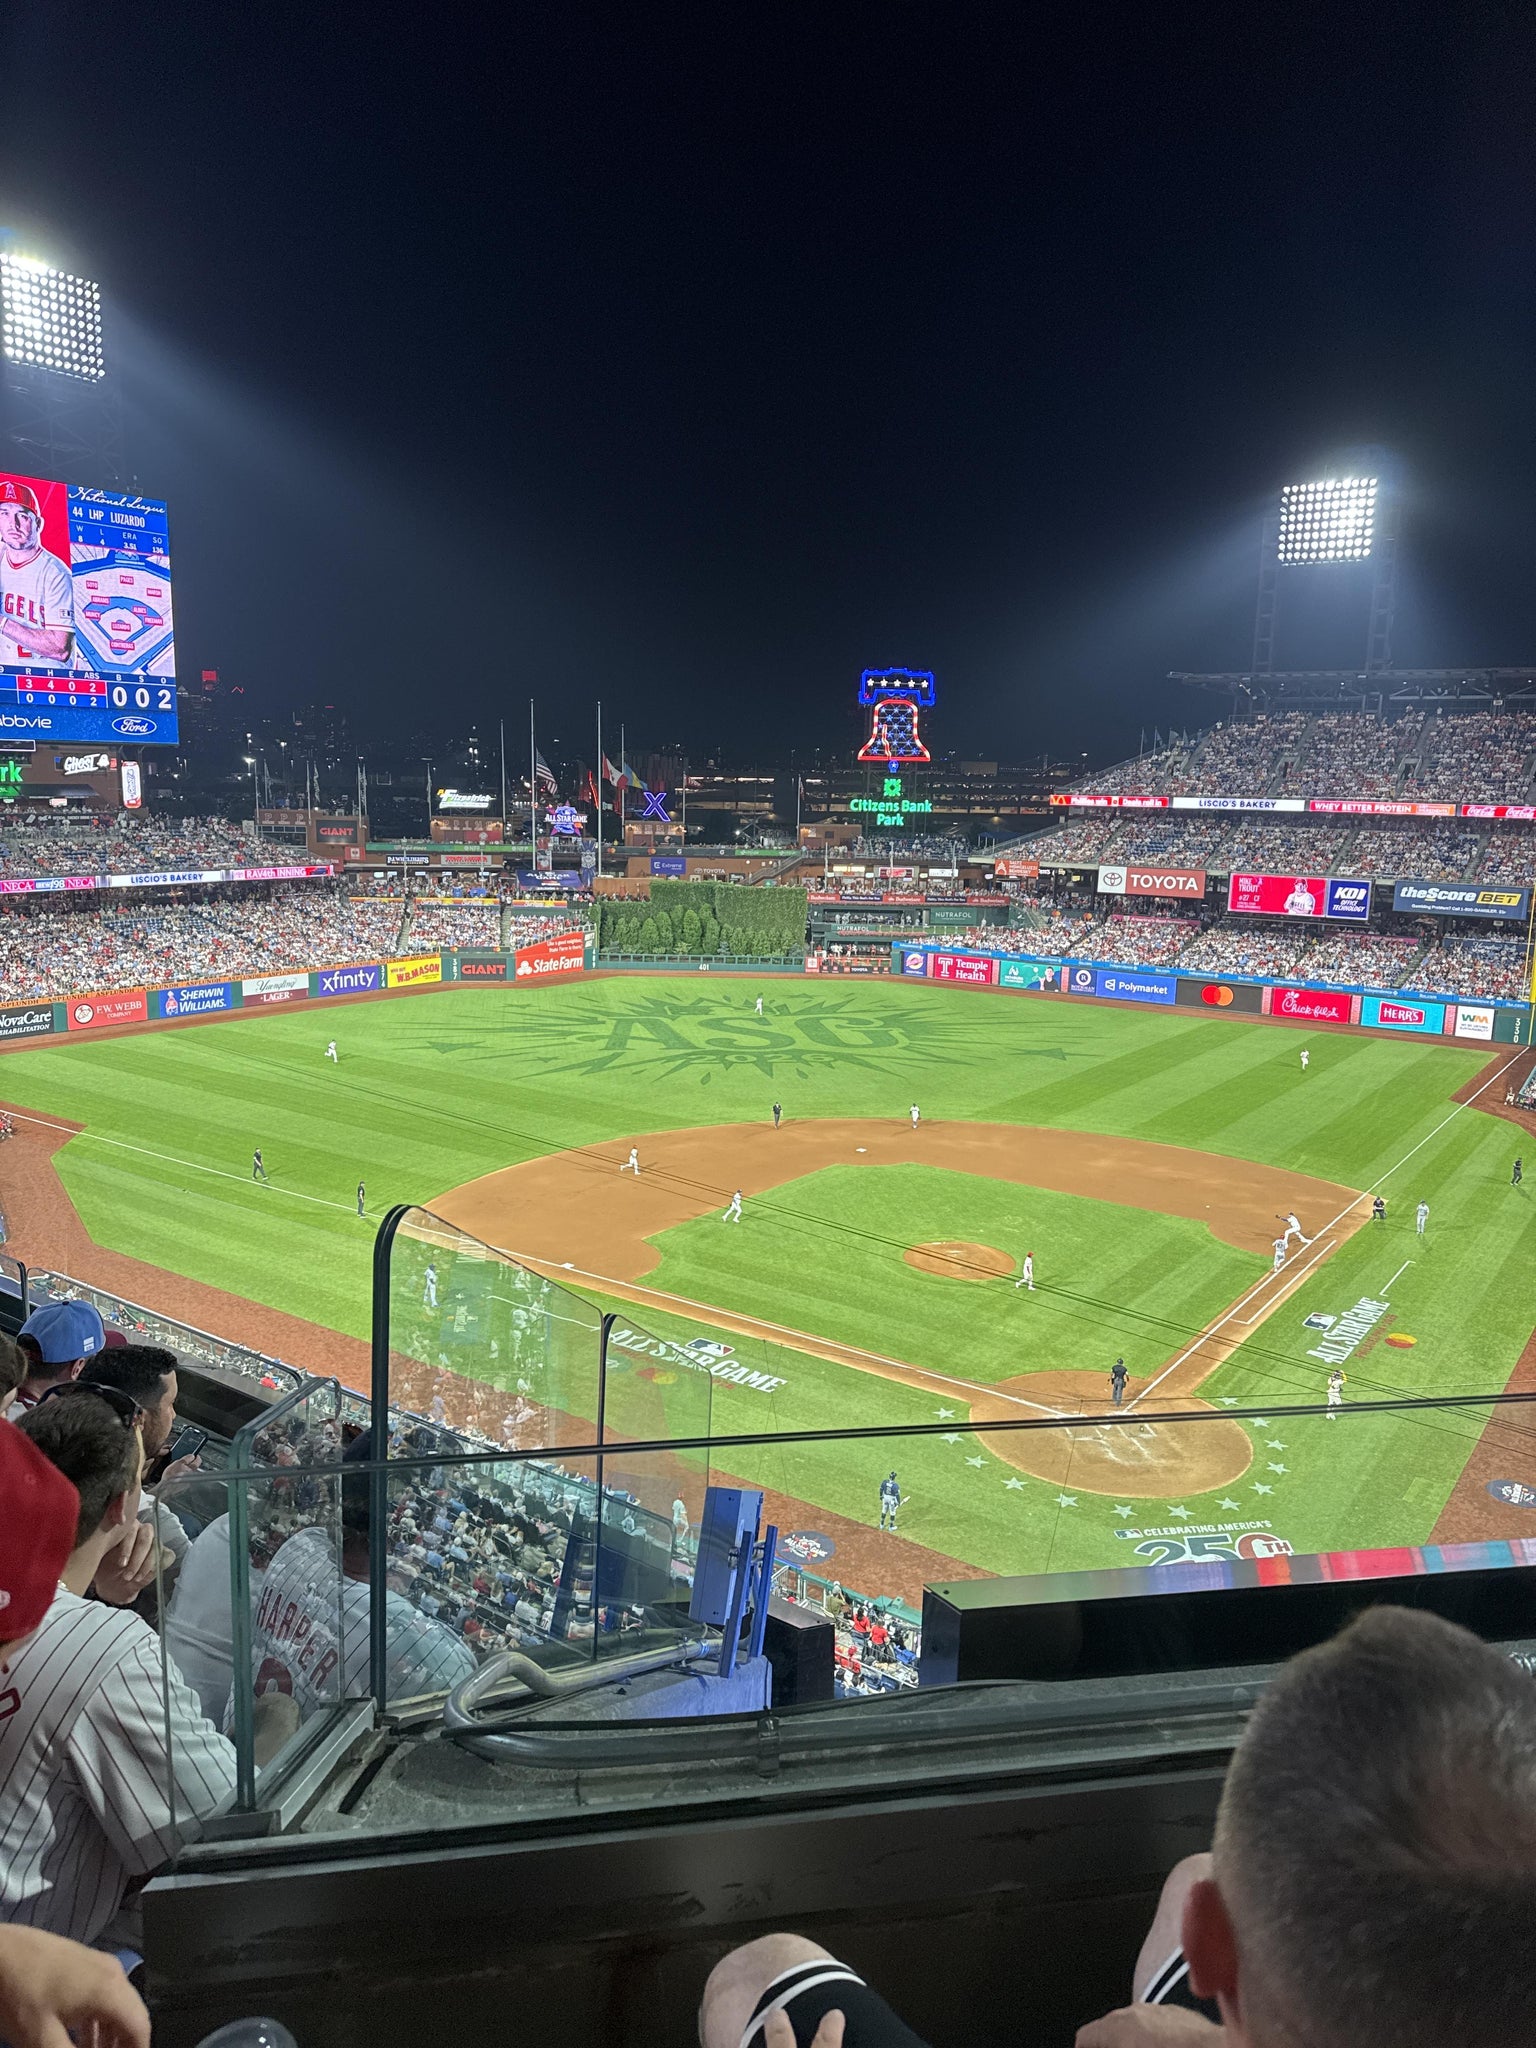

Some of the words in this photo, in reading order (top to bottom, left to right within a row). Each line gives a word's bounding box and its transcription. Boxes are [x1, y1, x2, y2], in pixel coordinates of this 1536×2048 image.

[68, 486, 125, 507] National
[126, 496, 165, 515] League
[72, 506, 83, 518] 44
[88, 508, 104, 520] LHP
[110, 511, 146, 528] LUZARDO
[100, 528, 104, 536] L
[122, 532, 137, 540] ERA
[152, 536, 163, 545] SO
[47, 669, 53, 677] H
[84, 672, 100, 680] ABS
[138, 675, 144, 683] S
[26, 679, 32, 689] 3
[47, 680, 54, 690] 4
[68, 681, 75, 691] 0
[89, 682, 96, 692] 2
[26, 693, 34, 703] 0
[48, 694, 55, 704] 0
[69, 695, 77, 706] 0
[90, 697, 97, 707] 2
[112, 686, 128, 707] 0
[135, 688, 150, 708] 0
[157, 689, 172, 710] 2
[120, 718, 149, 733] Ford
[64, 753, 100, 776] GHOST
[850, 799, 900, 813] Citizens
[901, 799, 933, 813] Bank
[1199, 799, 1237, 808] LISCIO'S
[1240, 799, 1277, 809] BAKERY
[1341, 803, 1373, 812] BETTER
[1374, 804, 1412, 813] PROTEIN
[545, 813, 556, 822] ALL
[557, 814, 571, 822] STAR
[571, 814, 588, 823] GAME
[876, 813, 904, 826] Park
[319, 827, 354, 836] GIANT
[130, 875, 168, 884] LISCIO'S
[170, 873, 204, 883] BAKERY
[246, 869, 276, 881] RAV4th
[276, 867, 306, 878] INNING
[1238, 877, 1252, 885] MIKE
[2, 881, 33, 893] NECA
[66, 876, 95, 889] NECA
[1130, 874, 1199, 891] TOYOTA
[1238, 884, 1259, 893] TROUT
[1334, 887, 1367, 900] KDI
[1400, 886, 1476, 902] theScore
[1480, 893, 1518, 904] BET
[1332, 904, 1365, 913] TECHNOLOGY
[1341, 899, 1359, 907] OFFICE
[461, 964, 506, 975] GIANT
[698, 963, 710, 971] 401
[955, 958, 989, 971] Temple
[322, 969, 376, 993] xfinity
[955, 969, 986, 981] Health
[95, 987, 135, 997] ASPLUNDH
[142, 983, 179, 991] ASPLUNDH
[255, 977, 297, 993] Yuengling
[1119, 981, 1168, 995] Polymarket
[48, 993, 89, 1002] ASPLUNDH
[180, 987, 224, 1001] SHERWIN
[263, 992, 290, 1002] LAGER
[115, 1001, 142, 1010] WEBB
[1281, 996, 1339, 1018] Chick-fil-A
[107, 1011, 131, 1019] COMPANY
[1383, 1007, 1419, 1022] HERR'S
[1461, 1013, 1489, 1024] WM
[599, 1016, 900, 1051] ASG
[1513, 1018, 1521, 1043] 330
[1341, 1296, 1391, 1324] GAME
[1322, 1319, 1373, 1345] STAR
[609, 1329, 658, 1352] ALL
[649, 1341, 716, 1373] STAR
[710, 1359, 788, 1393] GAME
[1144, 1525, 1216, 1536] CELEBRATING
[1217, 1519, 1273, 1531] AMERICA'S
[256, 1585, 339, 1692] HARPER
